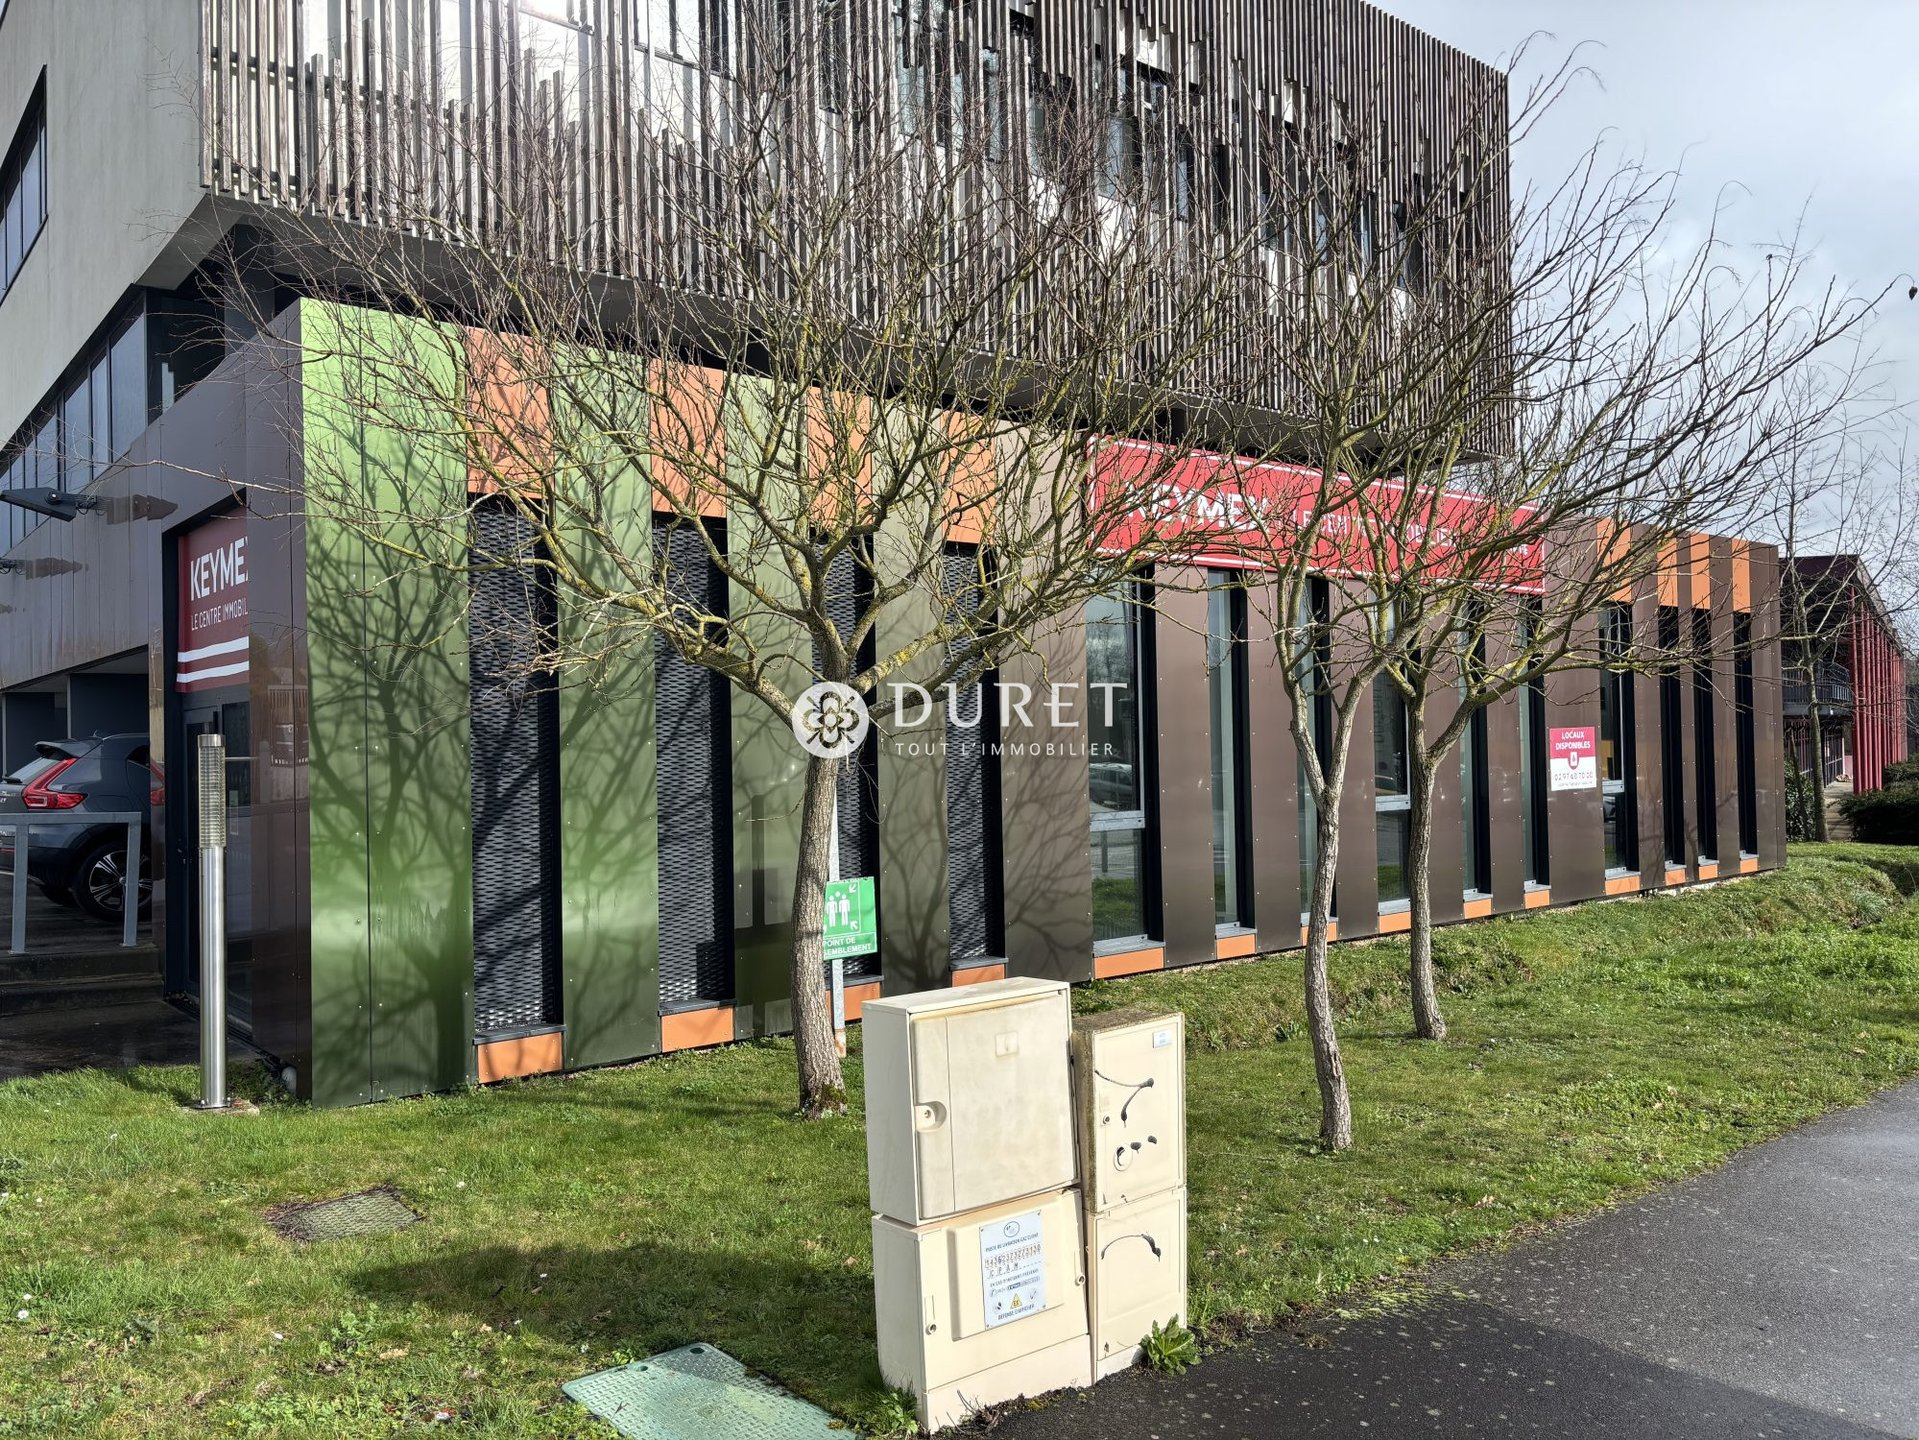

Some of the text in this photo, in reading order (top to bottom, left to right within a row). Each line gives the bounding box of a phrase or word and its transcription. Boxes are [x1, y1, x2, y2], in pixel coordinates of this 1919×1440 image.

[191, 614, 199, 631] LE
[199, 605, 221, 628] CENTRE
[1561, 731, 1585, 740] LOCAUX
[1555, 741, 1591, 750] DISPONIBLES
[845, 936, 857, 945] DE
[826, 943, 871, 955] EMBLEMENT
